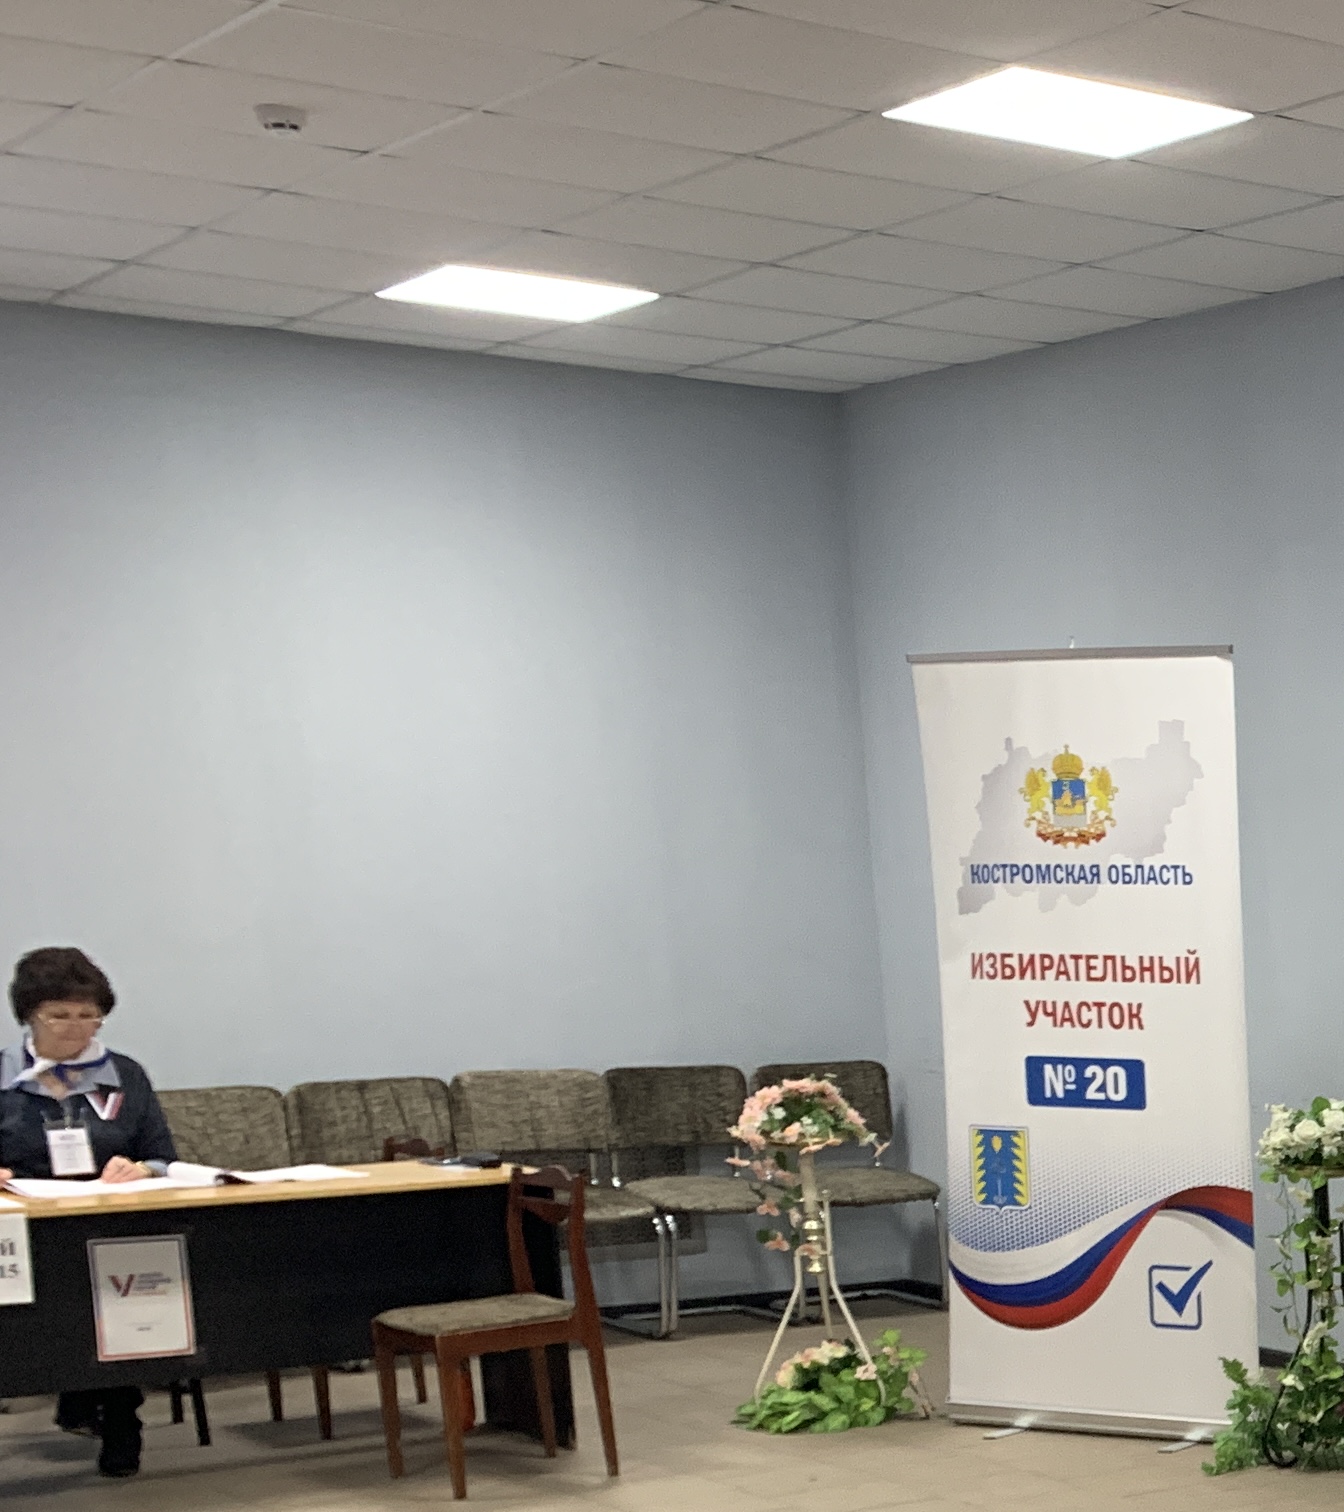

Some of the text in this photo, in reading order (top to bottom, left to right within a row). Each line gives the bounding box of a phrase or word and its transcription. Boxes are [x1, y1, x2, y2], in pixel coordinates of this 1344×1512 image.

[970, 863, 1193, 886] КОСТРОМСКАЯ ОБЛАСТЬ
[970, 949, 1201, 985] ИЗБИРАТЕЛЬНЫЙ
[1023, 1000, 1145, 1030] УЧАСТОК
[1043, 1063, 1128, 1102] № 20
